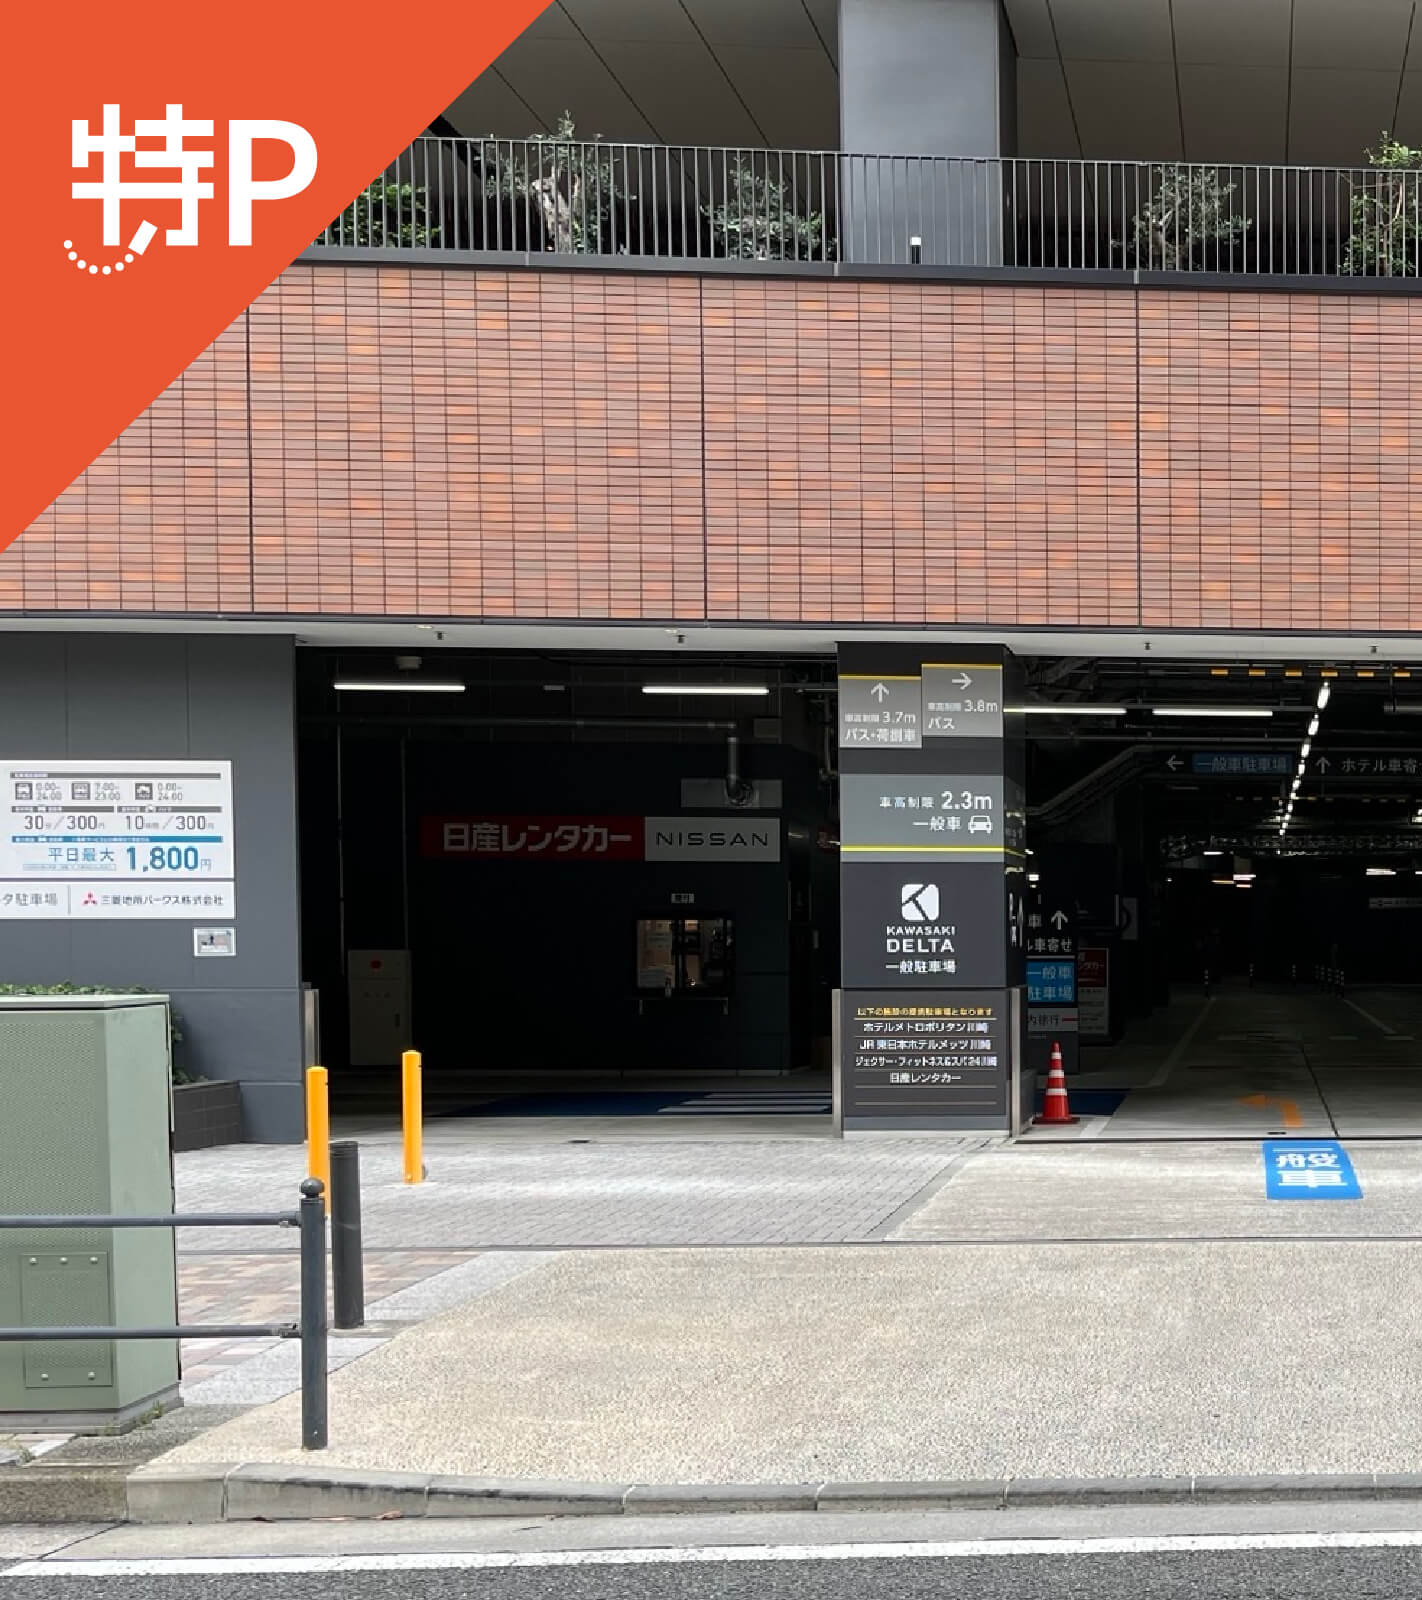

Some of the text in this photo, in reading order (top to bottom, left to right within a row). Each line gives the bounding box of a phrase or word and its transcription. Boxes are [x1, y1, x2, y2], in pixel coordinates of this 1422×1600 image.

[964, 699, 998, 713] 3.8m
[882, 711, 916, 723] 3.7m
[927, 716, 955, 729] バス
[941, 790, 993, 810] 2.3m
[912, 816, 961, 832] 一般車
[443, 822, 769, 852] 日産レンタカー NISSAN
[48, 847, 115, 863] 平日最大
[0, 893, 57, 906] タ駐車場
[885, 925, 956, 936] KAWASAKI
[885, 938, 955, 953] DELTA
[885, 960, 956, 974] 一般駐車場
[889, 1073, 962, 1084] 日産レンタカー
